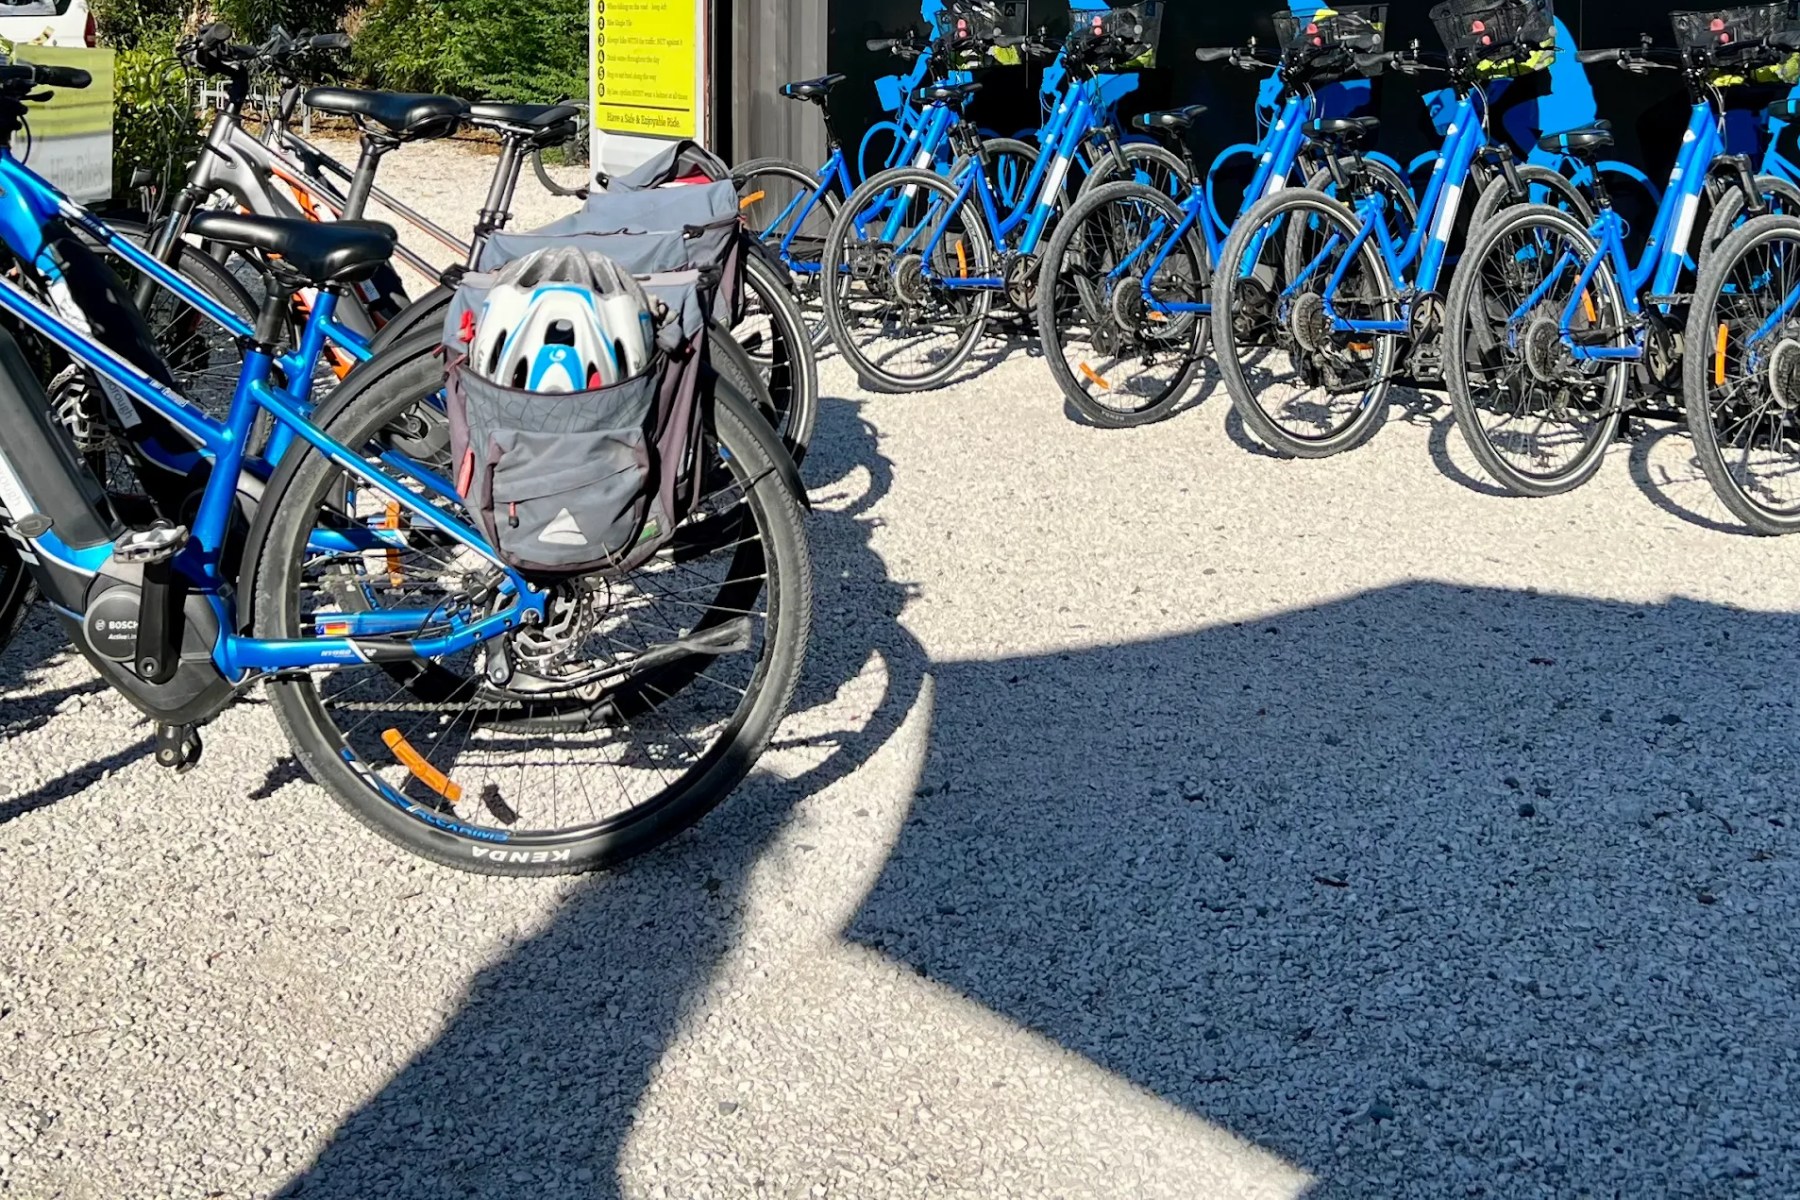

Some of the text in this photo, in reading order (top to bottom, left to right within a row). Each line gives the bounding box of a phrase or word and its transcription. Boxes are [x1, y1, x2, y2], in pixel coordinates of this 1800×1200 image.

[607, 111, 621, 123] Have
[624, 112, 636, 125] Safe
[641, 115, 667, 129] Enjoyable
[471, 845, 571, 865] KENDA
